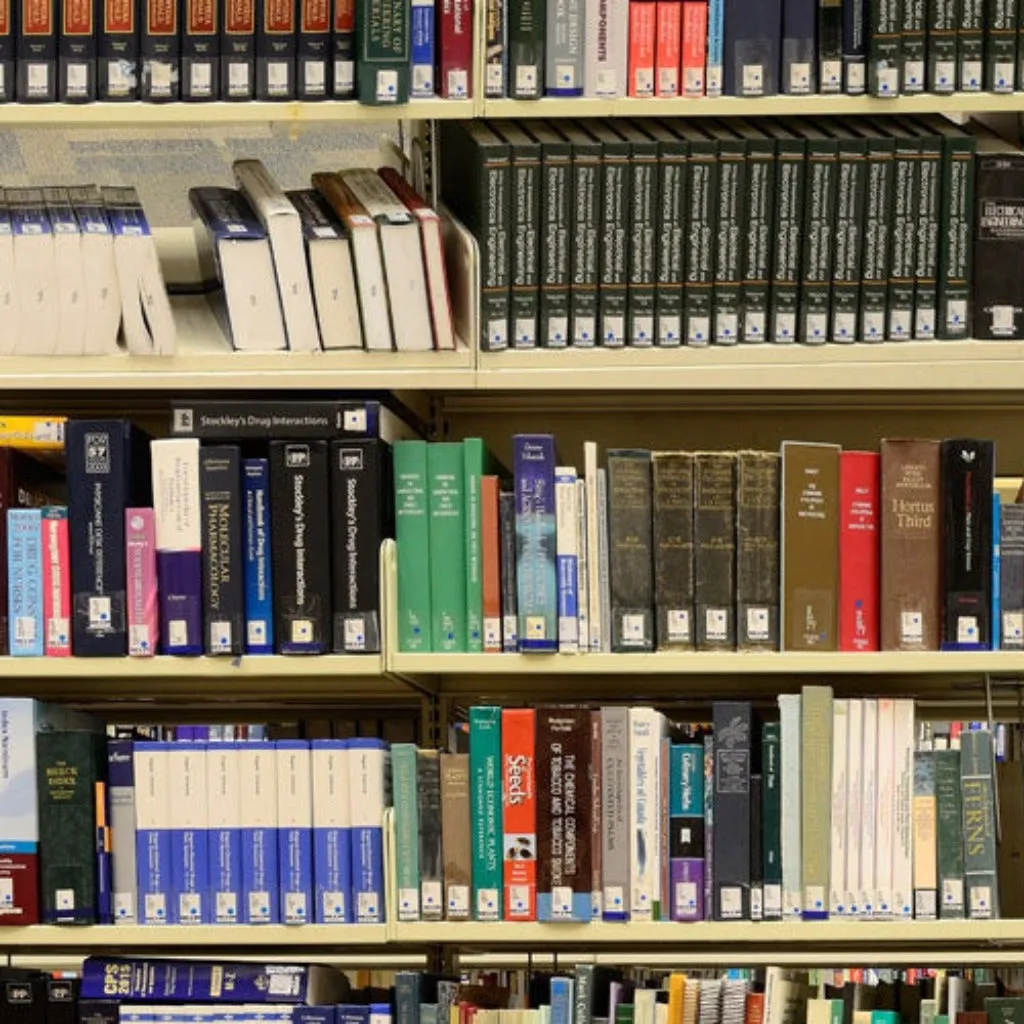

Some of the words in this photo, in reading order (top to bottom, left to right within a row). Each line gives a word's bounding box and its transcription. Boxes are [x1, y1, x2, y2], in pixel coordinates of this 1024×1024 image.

[250, 416, 268, 429] Drug
[271, 416, 328, 427] Interactions
[294, 524, 306, 548] Drug
[347, 526, 358, 550] Drug
[296, 549, 306, 605] Interactions
[349, 553, 358, 608] Interactions
[509, 755, 526, 804] Seeds
